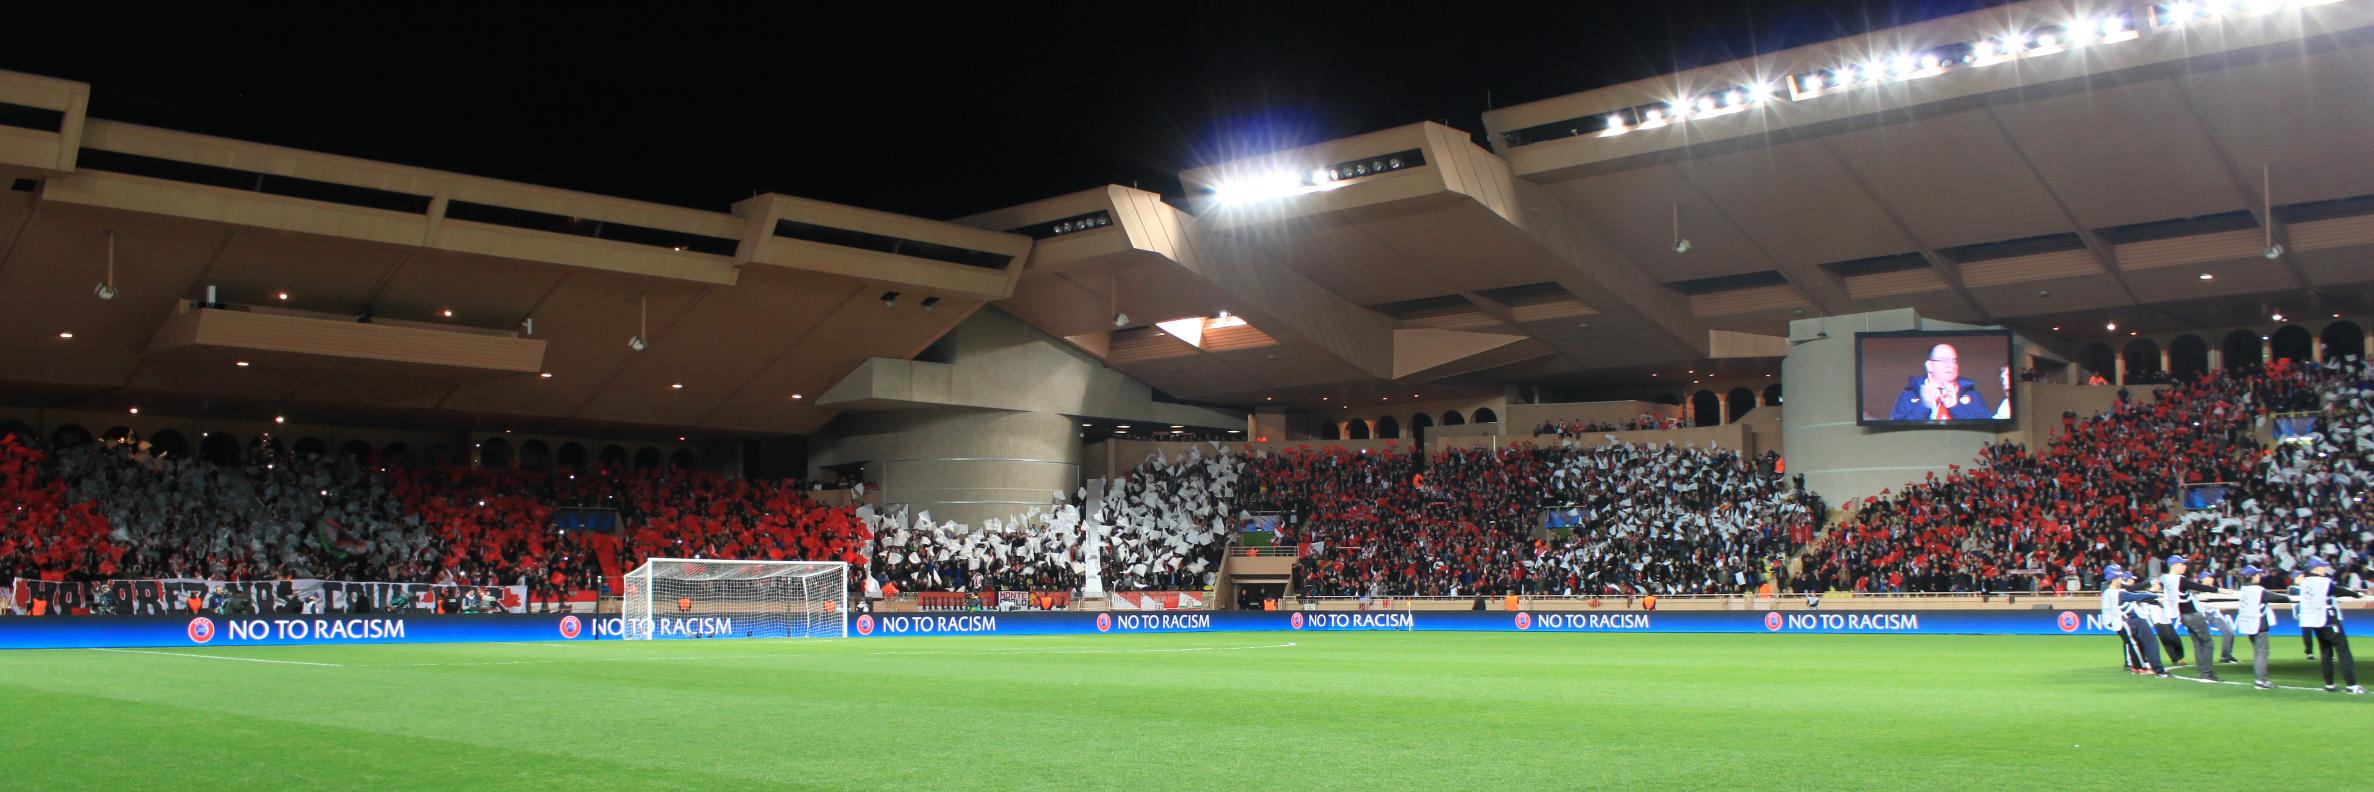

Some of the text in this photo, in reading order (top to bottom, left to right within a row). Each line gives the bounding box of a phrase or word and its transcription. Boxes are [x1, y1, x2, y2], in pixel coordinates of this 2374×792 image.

[592, 618, 622, 636] NO
[660, 617, 732, 635] RACISM
[884, 616, 996, 632] NO TO RACISM
[1118, 615, 1139, 629] NO
[1142, 615, 1159, 629] TO
[1163, 614, 1209, 628] RACISM
[1309, 614, 1413, 627] NO TO RACISM
[1539, 614, 1649, 628] NO TO RACISM
[1789, 614, 1918, 629] NO TO RACISM
[229, 619, 405, 639] NO TO RACISM
